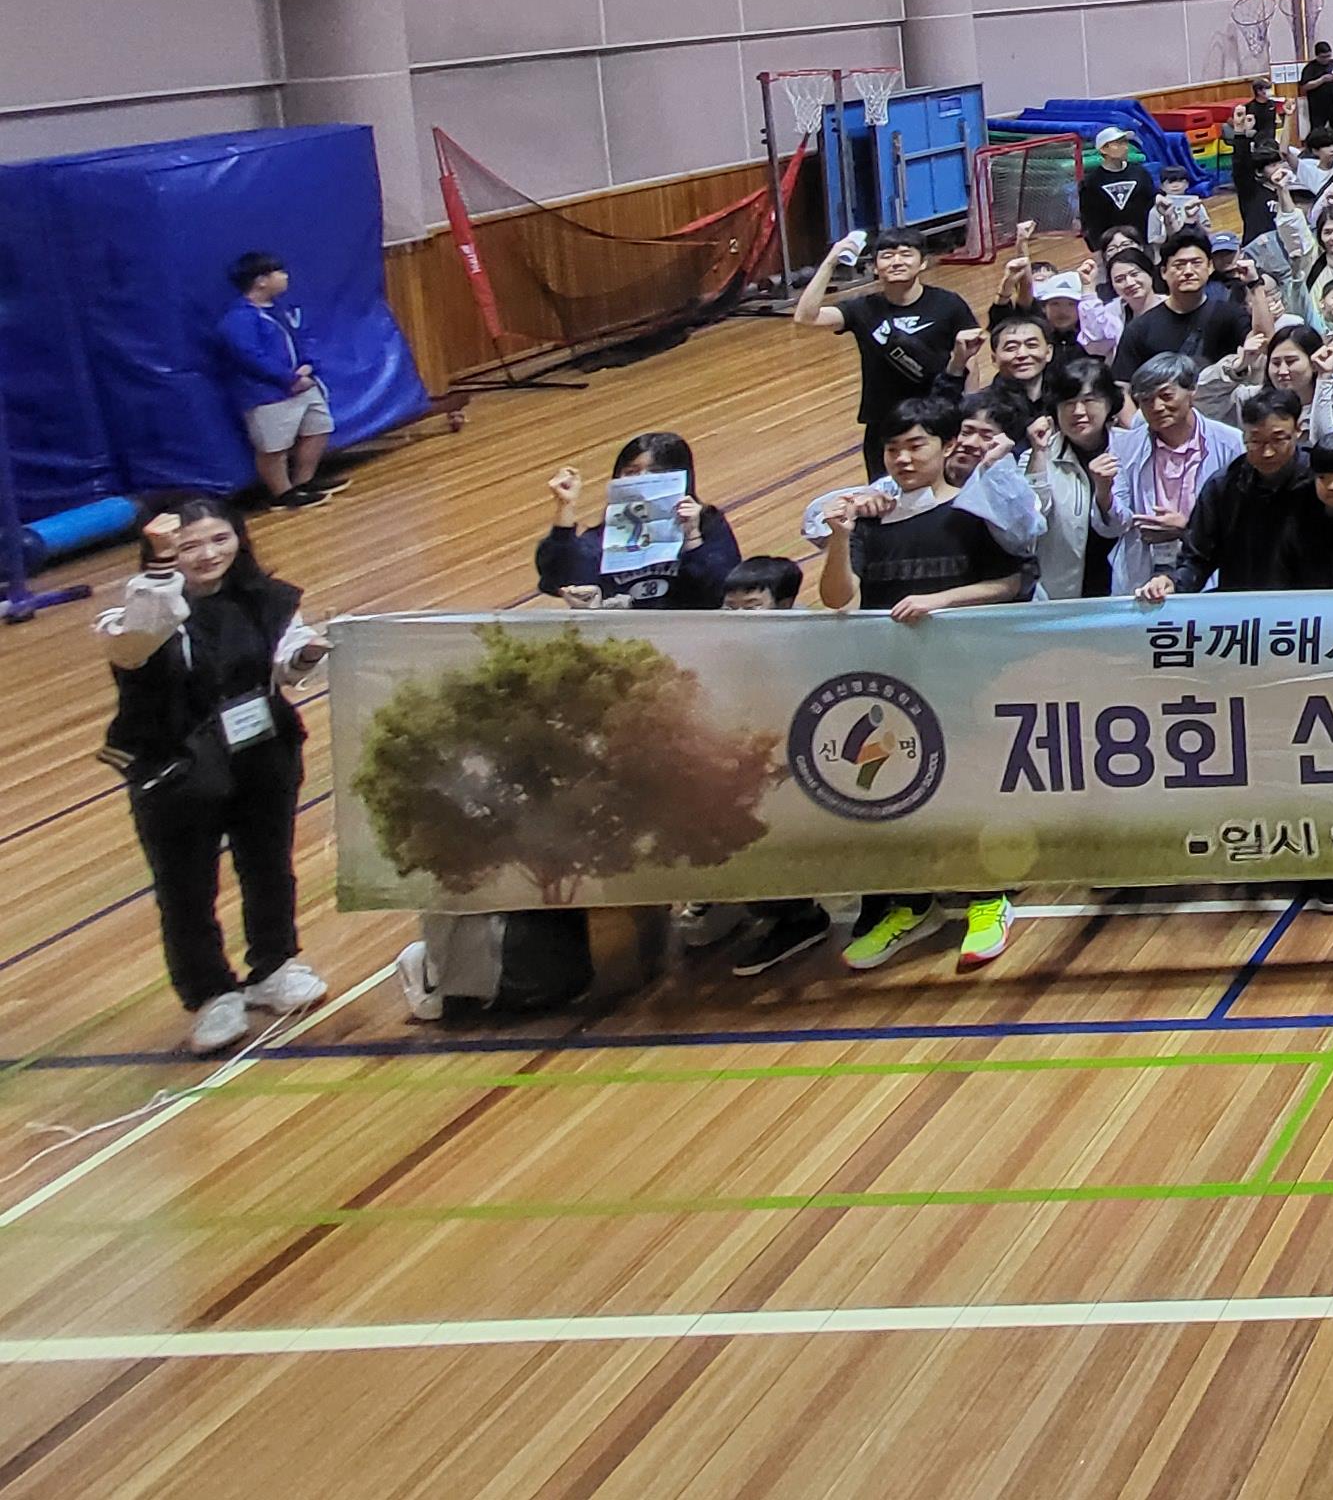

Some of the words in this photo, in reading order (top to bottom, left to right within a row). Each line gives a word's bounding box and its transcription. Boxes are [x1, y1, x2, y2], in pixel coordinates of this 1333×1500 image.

[642, 581, 658, 596] 38
[819, 739, 839, 762] 신
[898, 736, 918, 760] 명
[994, 695, 1249, 792] 제8회
[1220, 821, 1315, 861] 일시
